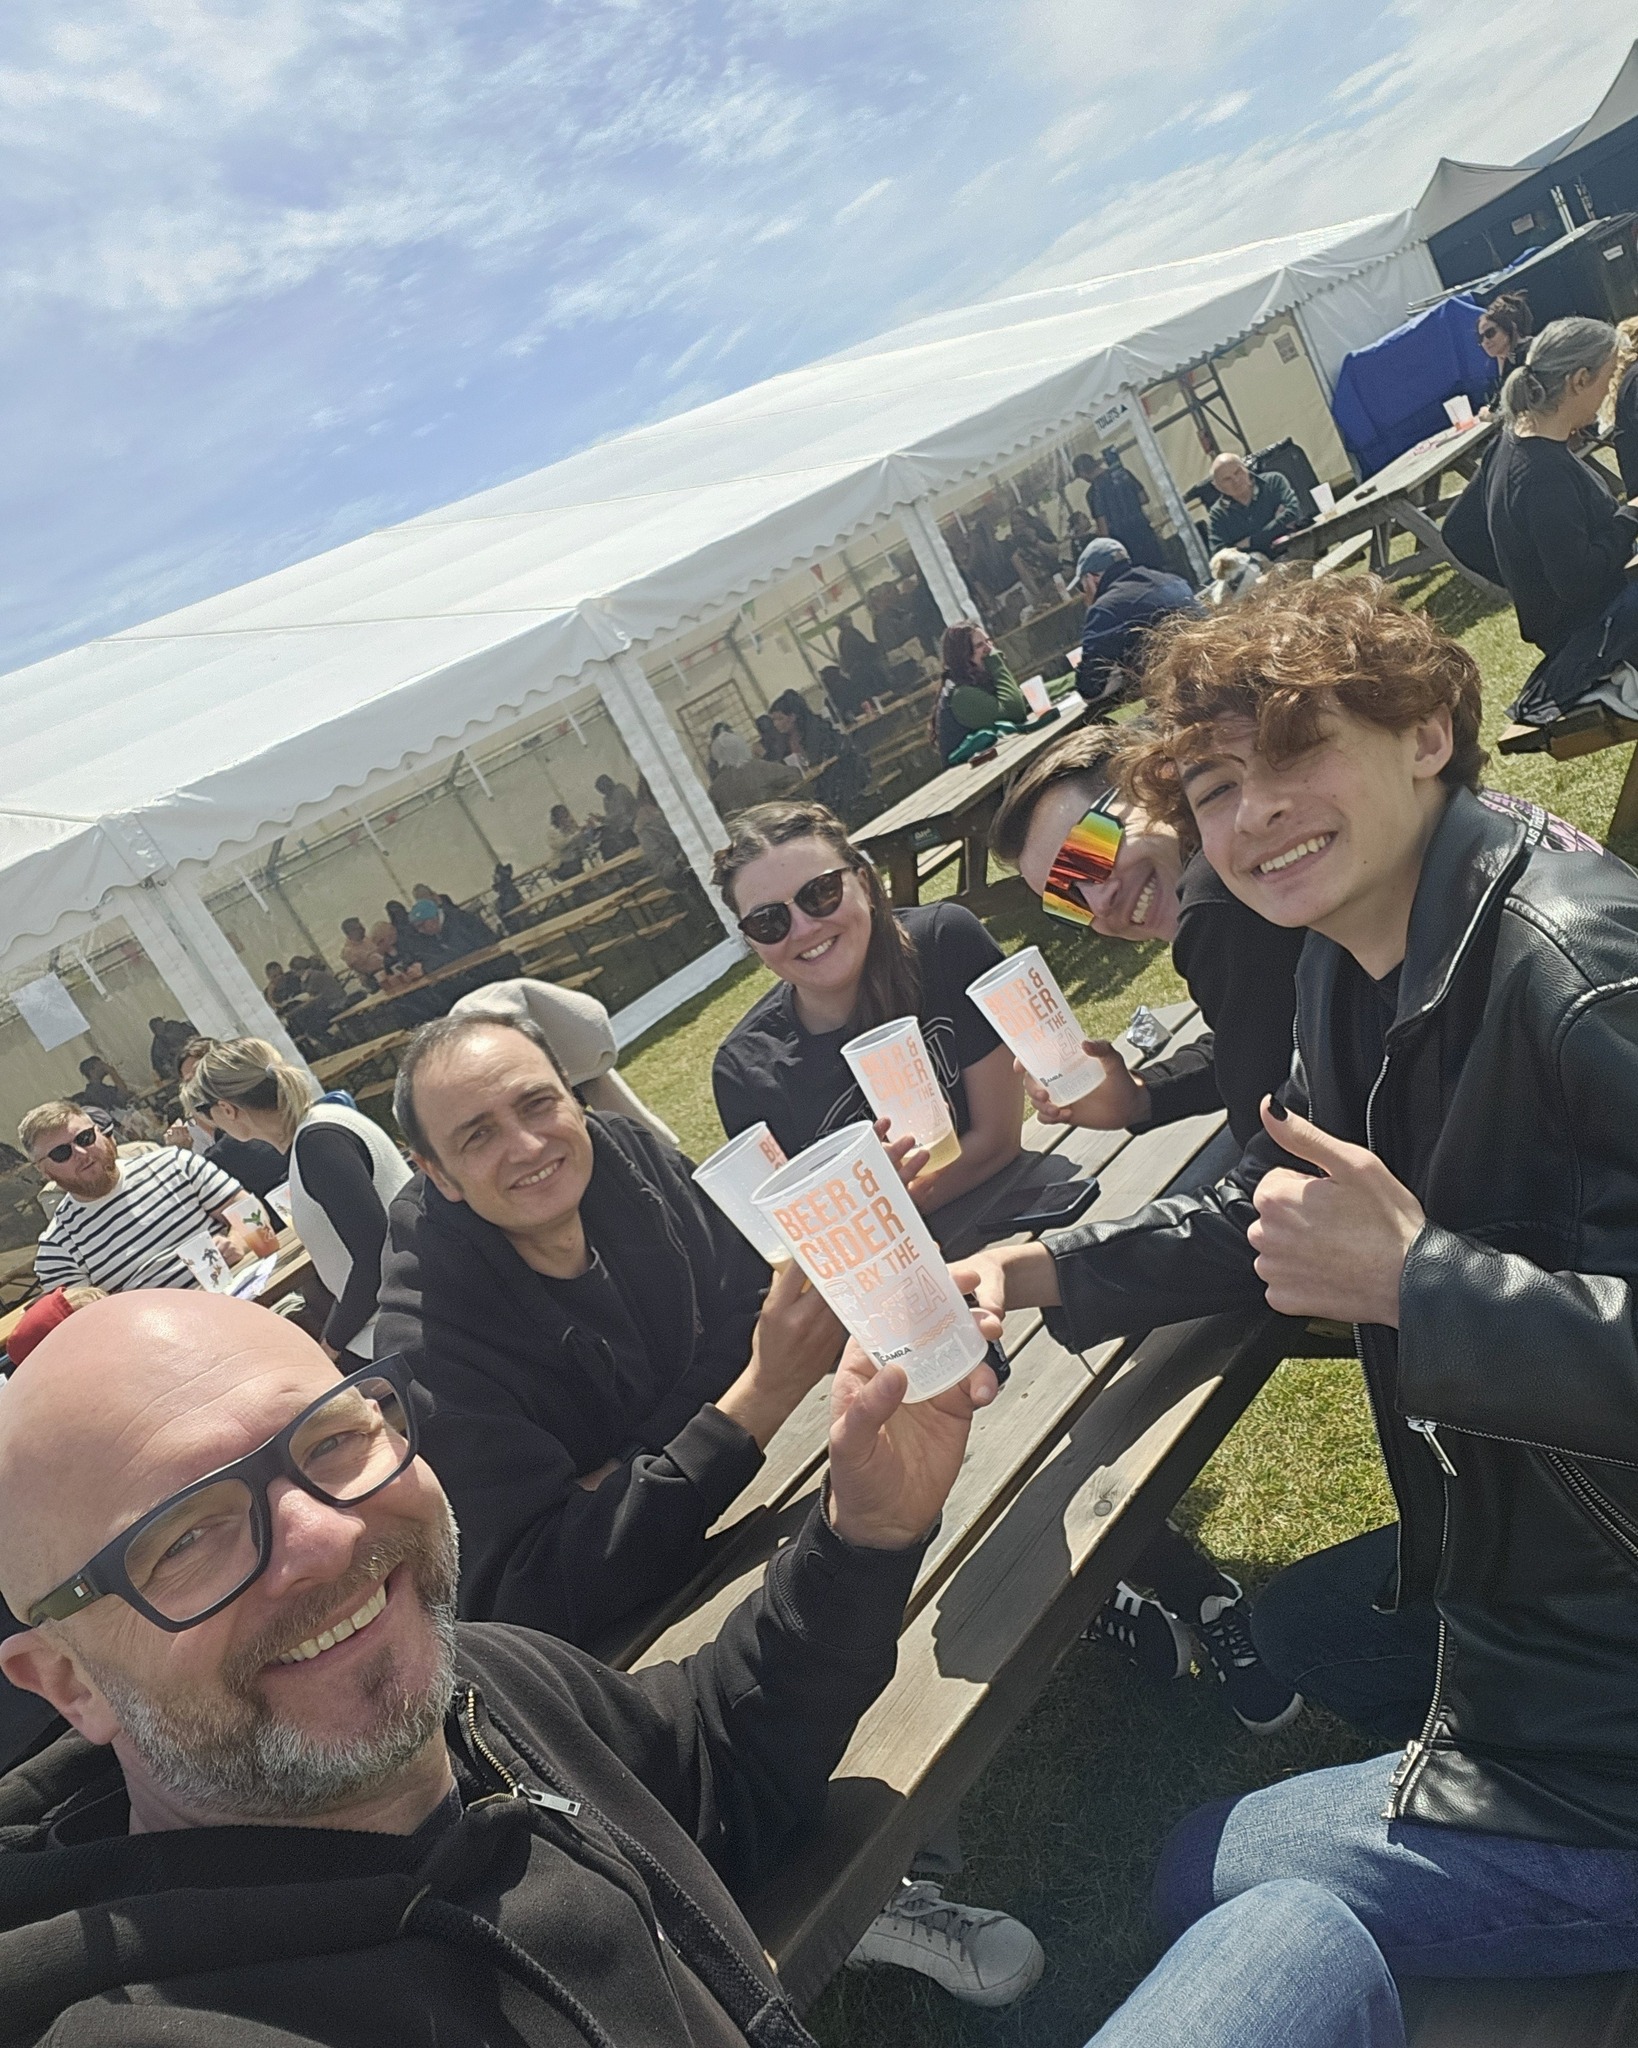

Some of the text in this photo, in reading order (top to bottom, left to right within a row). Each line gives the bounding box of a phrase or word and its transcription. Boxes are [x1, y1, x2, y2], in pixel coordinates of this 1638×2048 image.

[983, 967, 1044, 1016] BEER &
[997, 988, 1059, 1037] CIDER
[1045, 1011, 1067, 1033] THE
[858, 1035, 918, 1077] BEER &
[869, 1058, 929, 1103] CIDER
[918, 1082, 935, 1101] THE
[773, 1159, 880, 1242] BEER &
[799, 1196, 905, 1280] CIDER
[855, 1236, 920, 1293] BY THE
[880, 1265, 947, 1333] SEA
[880, 1347, 912, 1362] CAMRA
